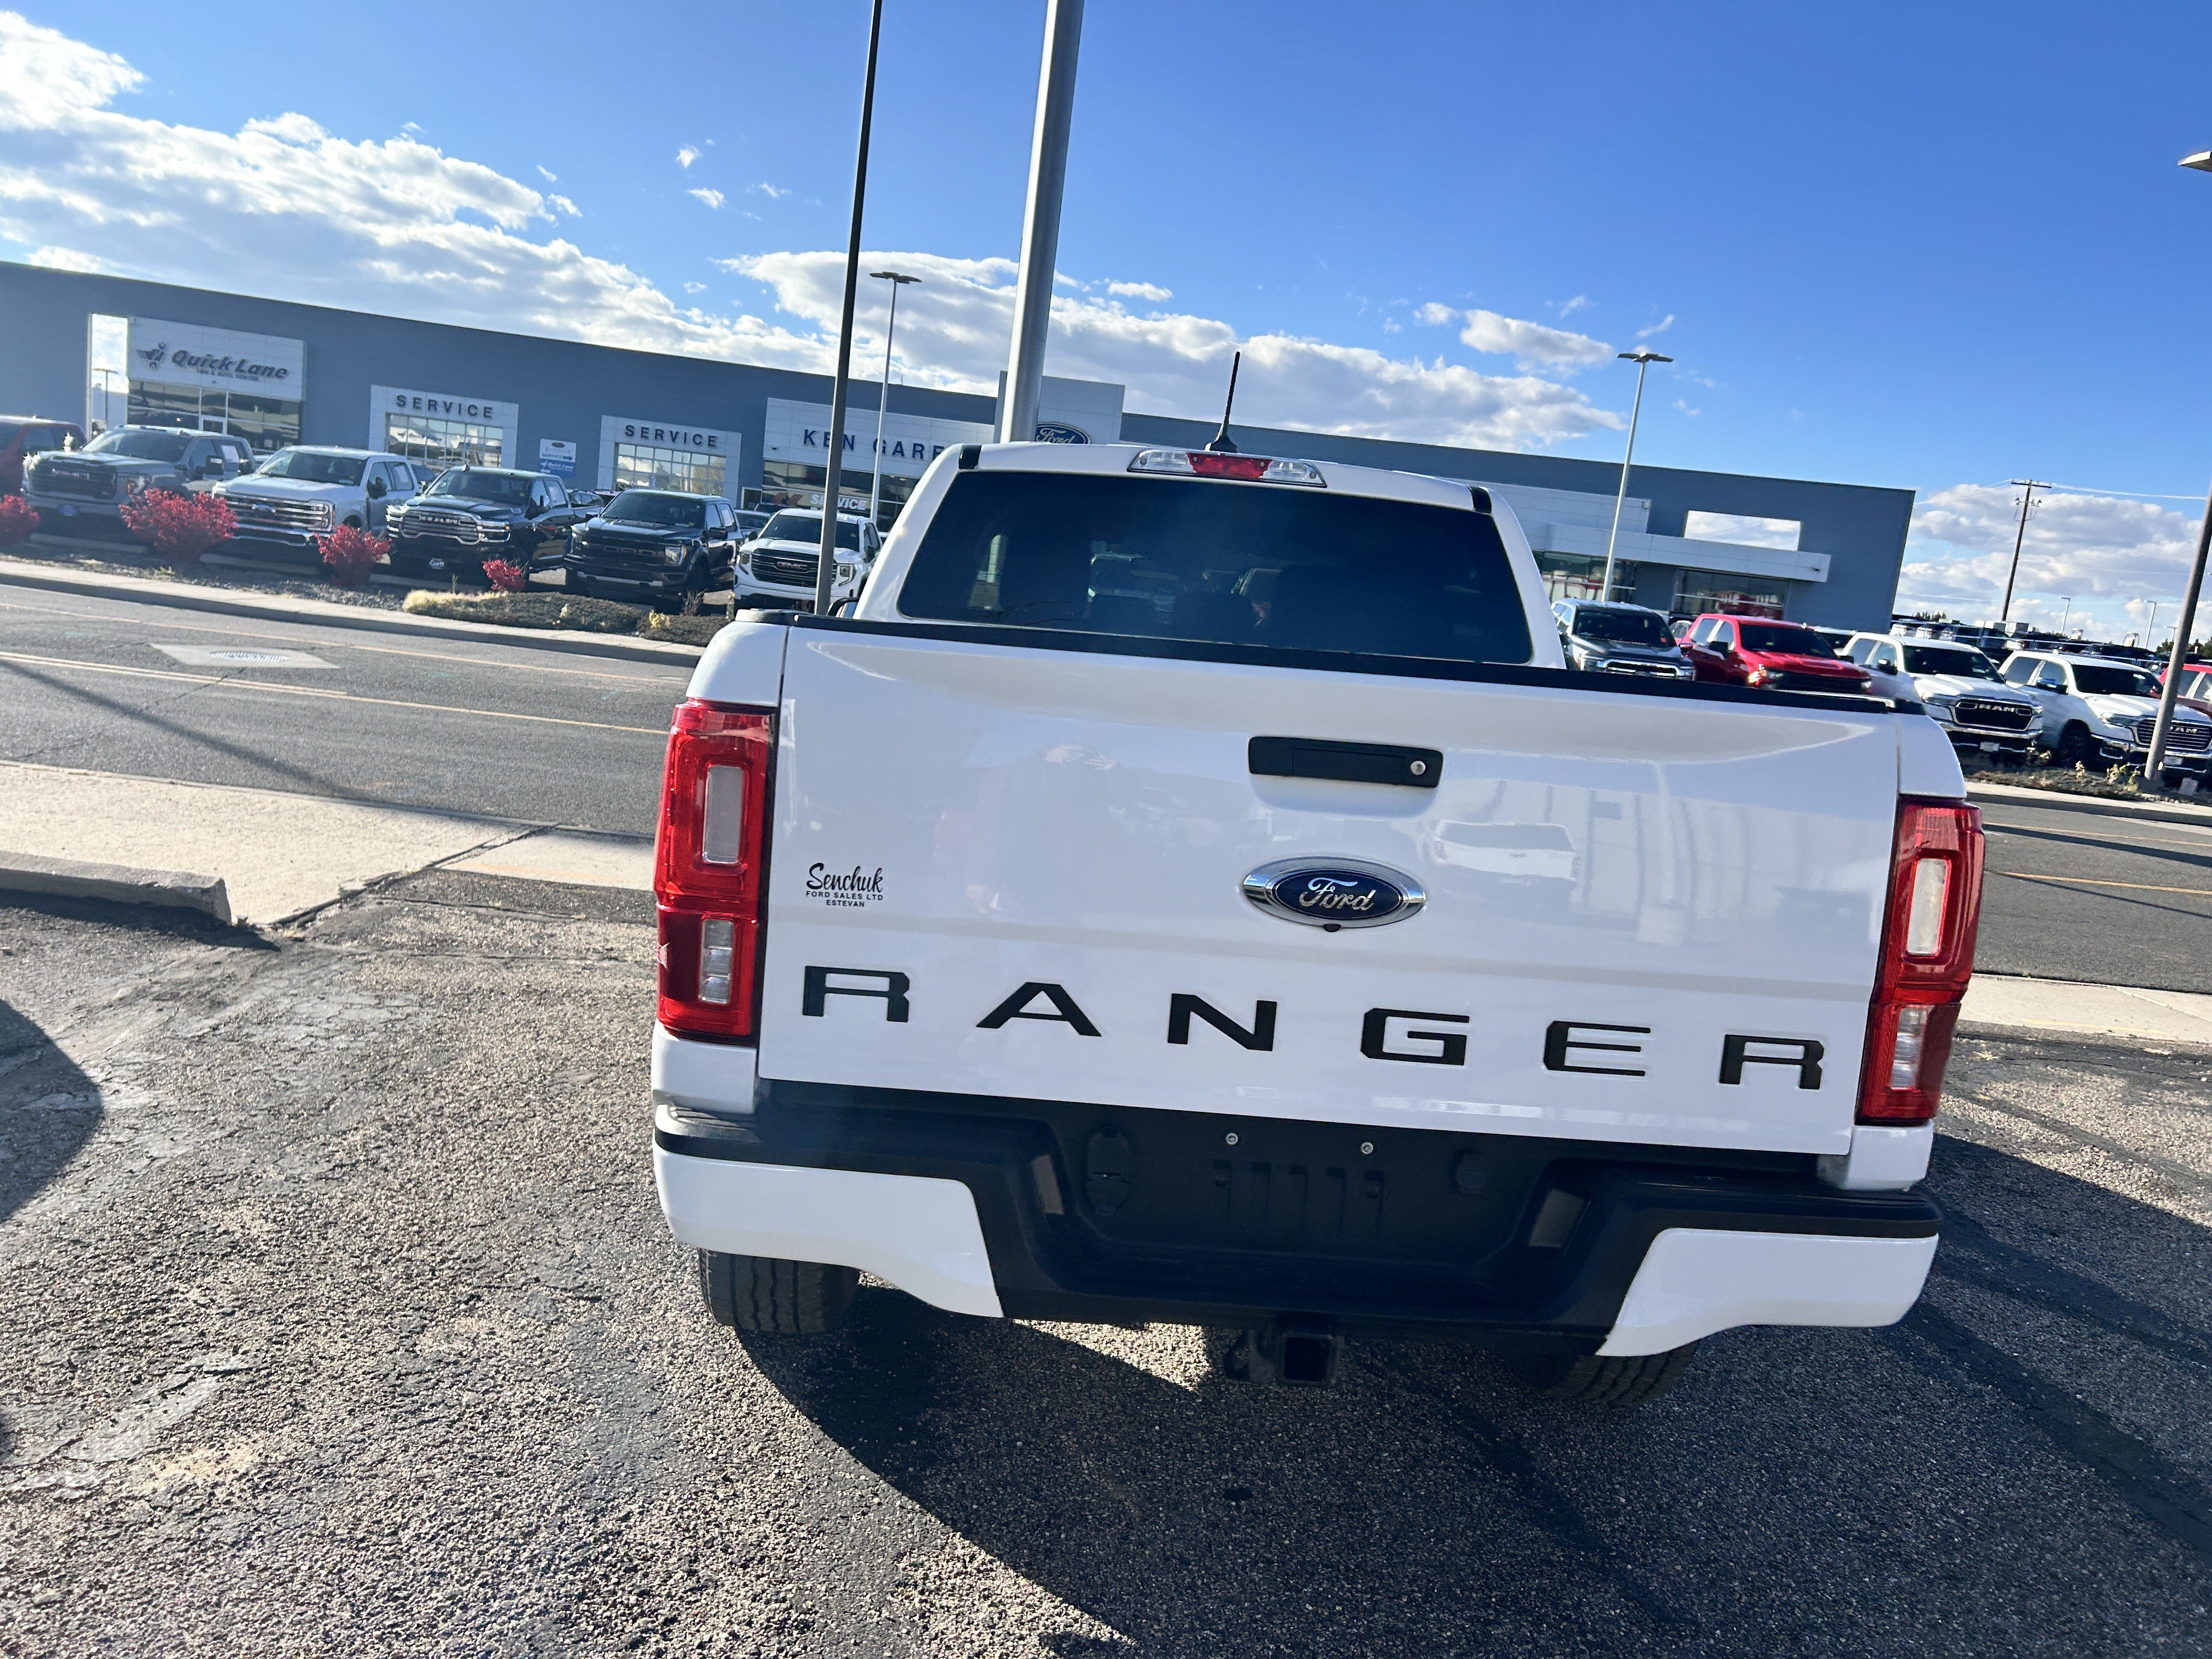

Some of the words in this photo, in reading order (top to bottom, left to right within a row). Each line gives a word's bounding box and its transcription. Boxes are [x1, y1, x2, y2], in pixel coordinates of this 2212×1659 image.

[172, 349, 233, 371] Quick
[235, 358, 288, 379] Lane
[396, 394, 493, 419] SERVICE
[625, 425, 718, 447] SERVICE
[803, 429, 855, 450] KEN
[810, 494, 867, 510] SEVICE
[1979, 704, 2015, 713] RAM
[806, 862, 883, 893] Senchuk
[1299, 877, 1376, 911] Ford
[803, 966, 1825, 1091] RANGER
